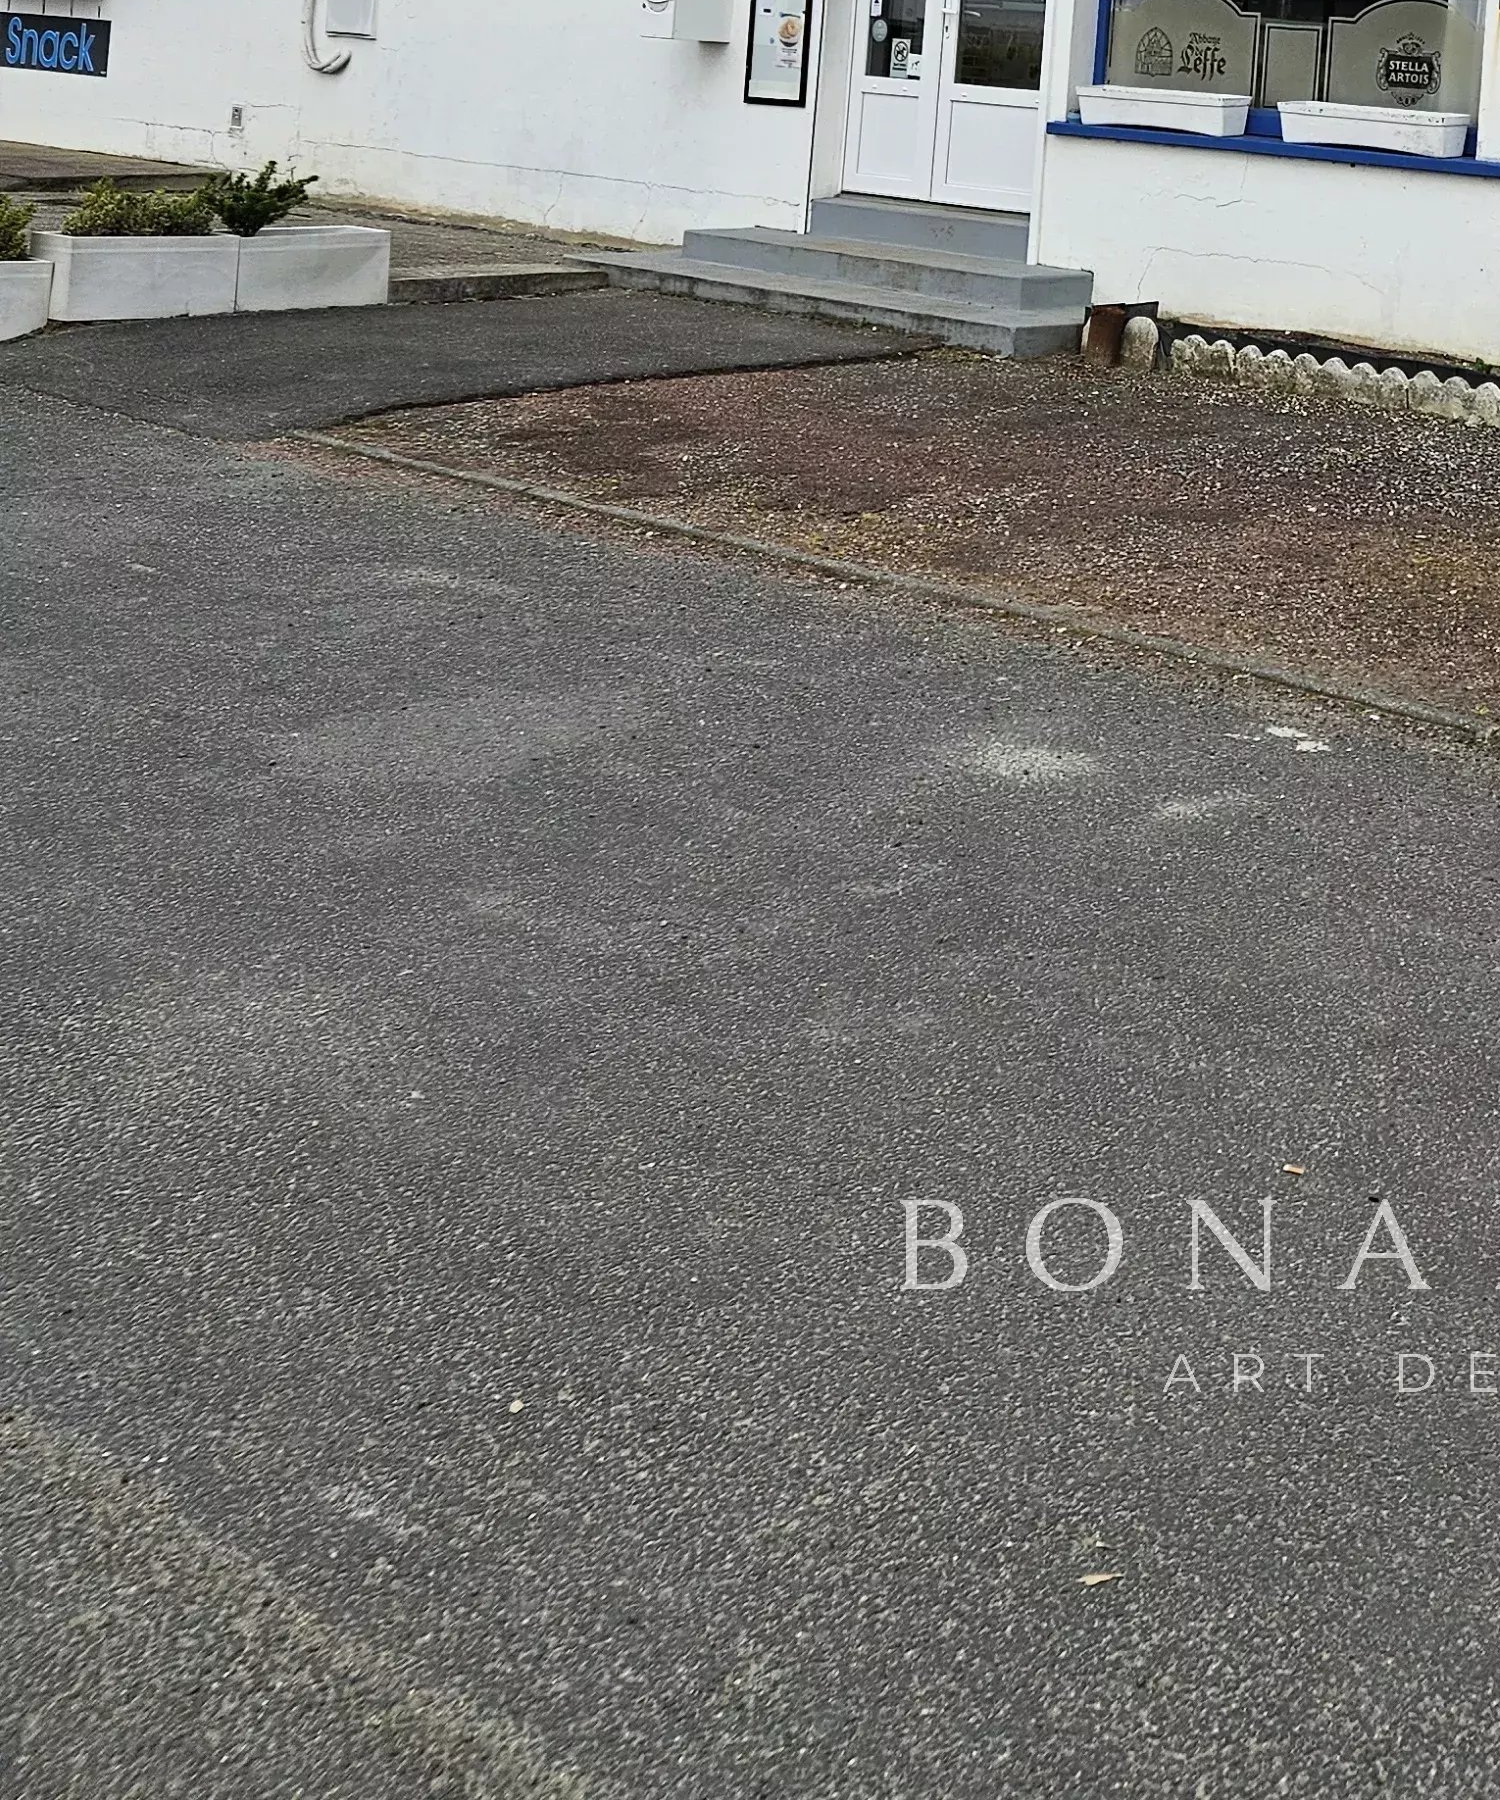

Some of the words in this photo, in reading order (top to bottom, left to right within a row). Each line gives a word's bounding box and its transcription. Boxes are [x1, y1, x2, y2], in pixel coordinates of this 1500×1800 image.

[5, 16, 96, 72] Snack
[1177, 43, 1227, 81] Leffe
[1388, 60, 1429, 73] STELLA
[1388, 72, 1429, 85] ARTOIS
